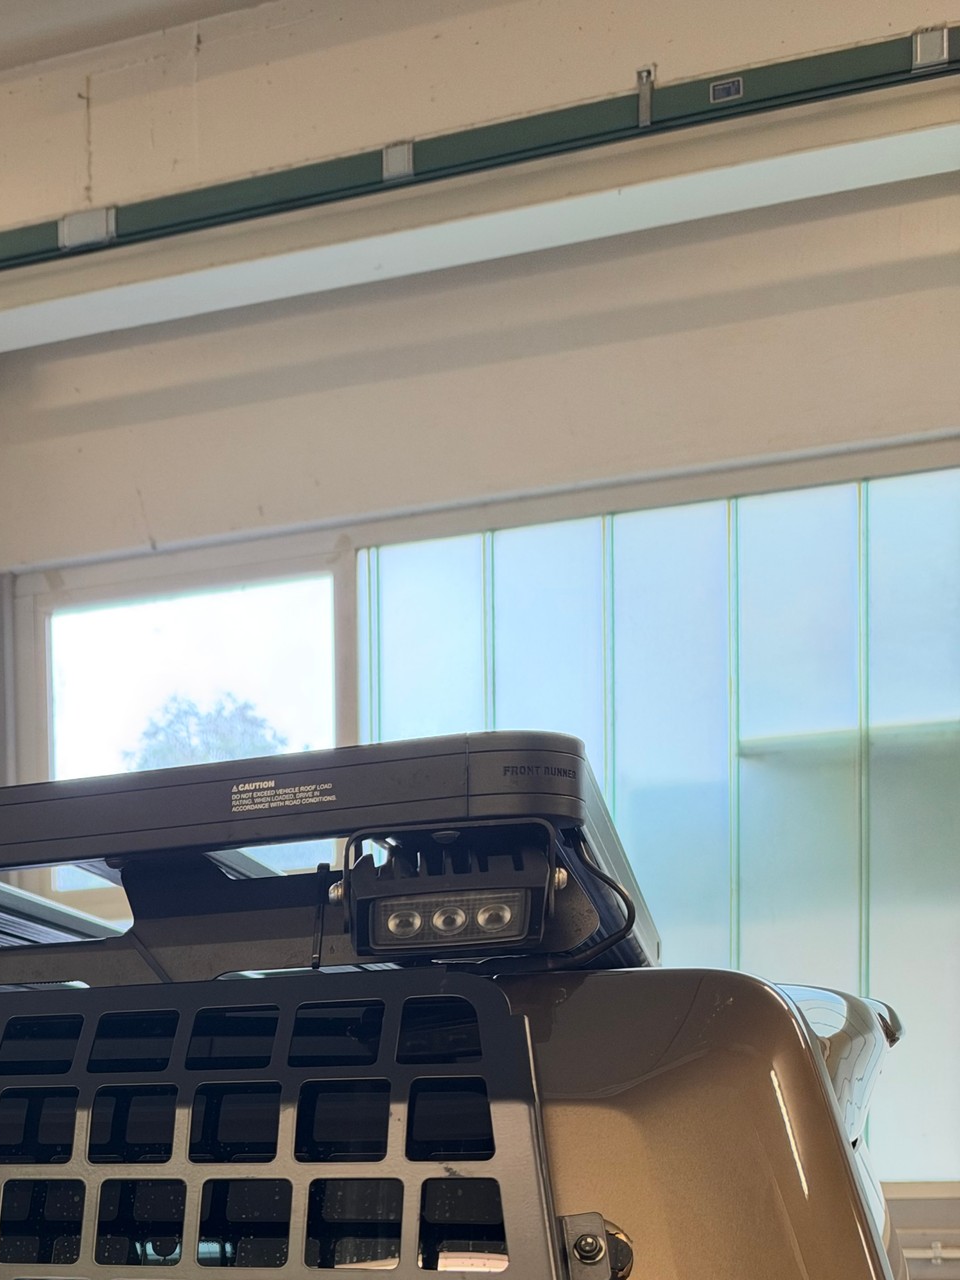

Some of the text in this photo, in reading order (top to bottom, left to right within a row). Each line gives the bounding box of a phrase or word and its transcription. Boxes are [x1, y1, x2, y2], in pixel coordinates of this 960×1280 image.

[503, 765, 576, 779] FRONT RUNNER
[238, 780, 275, 791] CAUTION
[253, 791, 275, 799] EXCEED
[232, 803, 269, 812] ACCORDANCE
